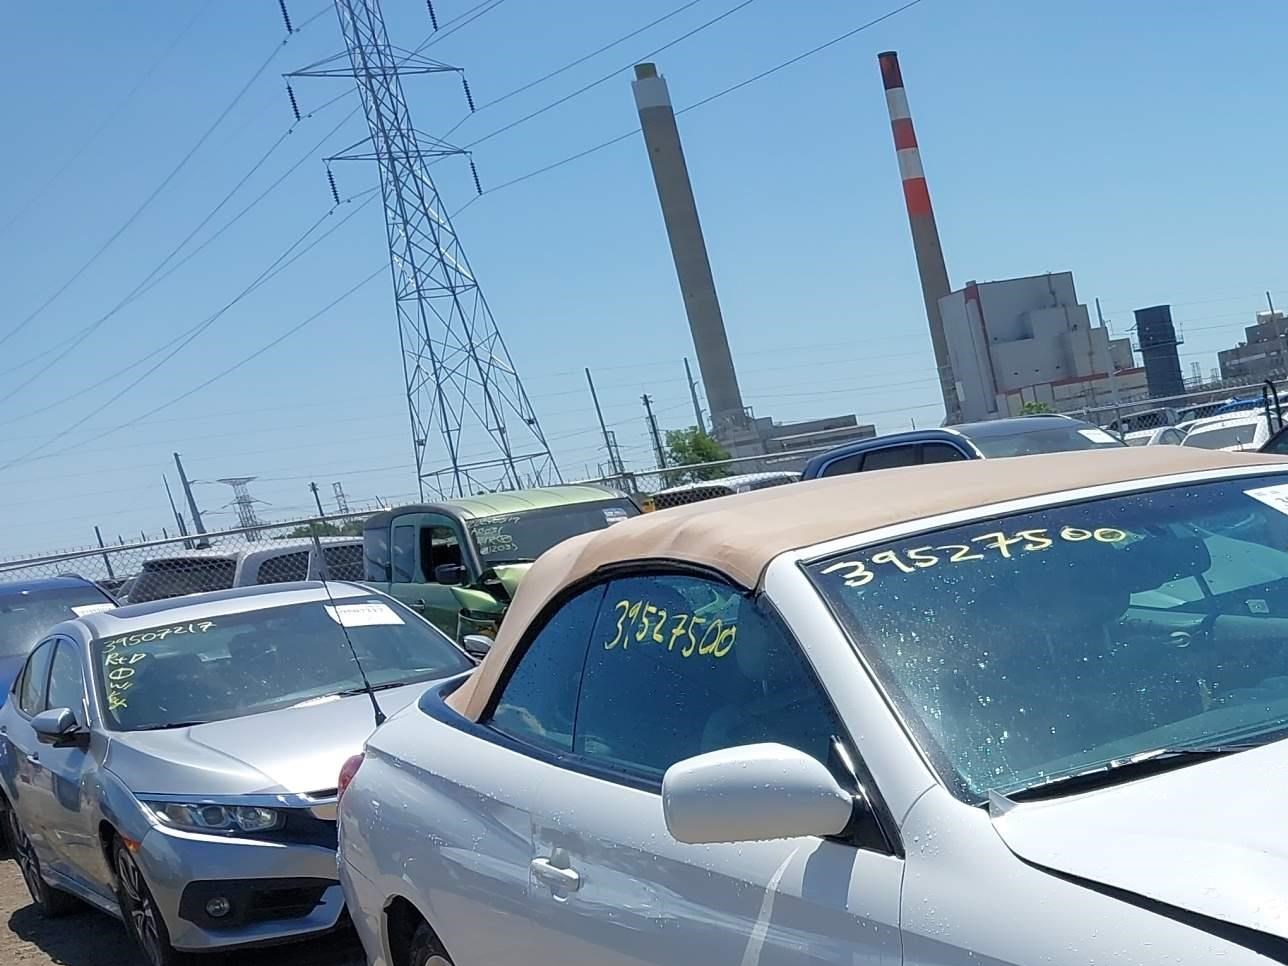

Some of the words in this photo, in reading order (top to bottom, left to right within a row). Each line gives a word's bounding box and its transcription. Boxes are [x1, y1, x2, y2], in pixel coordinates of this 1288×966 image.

[820, 527, 1127, 588] 39527500
[101, 621, 217, 654] 39507217
[604, 599, 737, 658] 39527500
